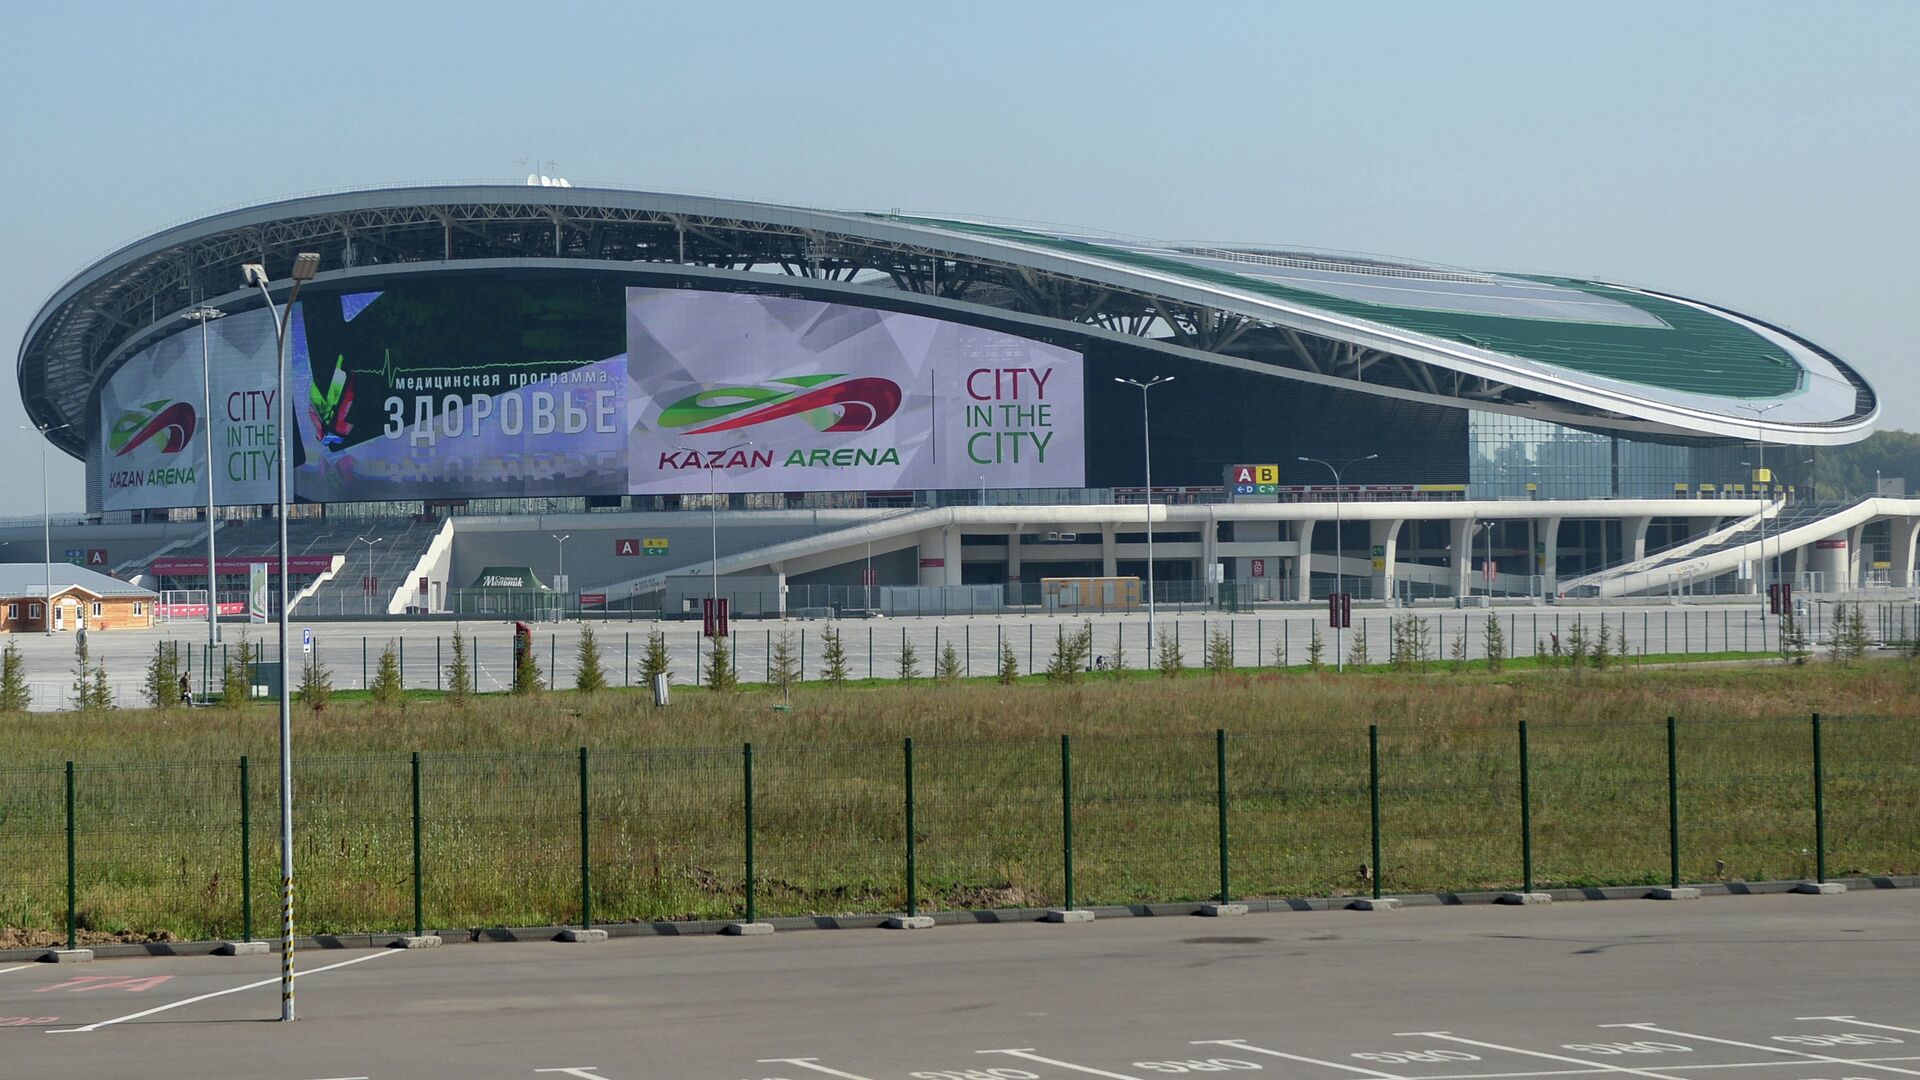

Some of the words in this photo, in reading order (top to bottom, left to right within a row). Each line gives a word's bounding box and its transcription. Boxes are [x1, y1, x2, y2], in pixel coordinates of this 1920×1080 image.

[395, 374, 500, 390] медицинская
[509, 369, 607, 388] программа
[967, 368, 1053, 400] CITY
[227, 390, 276, 422] CITY
[966, 405, 992, 427] IN
[999, 404, 1052, 427] THE
[383, 390, 617, 447] ЗДОРОВЬЕ
[228, 425, 242, 447] IN
[245, 424, 277, 447] THE
[658, 449, 773, 470] KAZAN
[783, 447, 901, 468] ARENA
[967, 431, 1054, 465] CITY
[228, 450, 277, 482] CITY
[1238, 468, 1252, 482] A
[1261, 468, 1272, 481] B
[109, 470, 144, 489] KAZAN
[147, 467, 196, 486] ARENA
[1246, 485, 1253, 493] D
[1259, 485, 1265, 493] C
[92, 551, 102, 564] A
[622, 541, 633, 554] A
